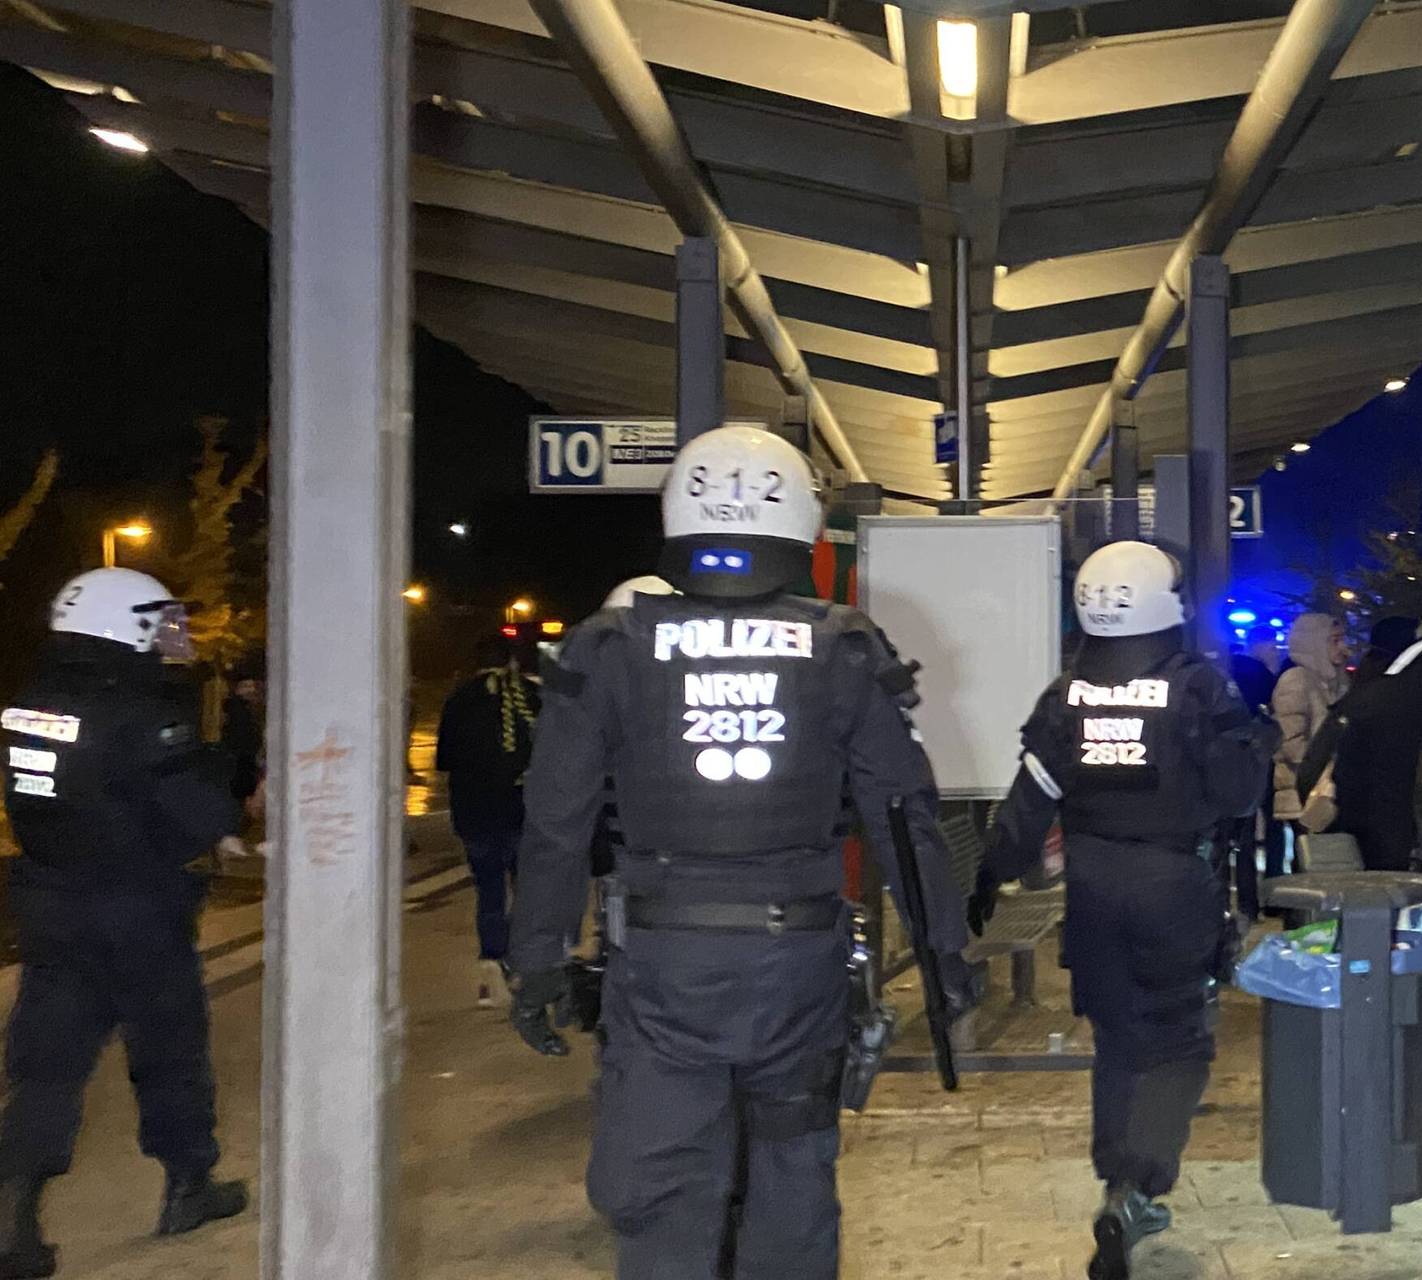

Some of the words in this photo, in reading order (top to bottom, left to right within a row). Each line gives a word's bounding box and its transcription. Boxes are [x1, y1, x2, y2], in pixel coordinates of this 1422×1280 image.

[541, 431, 600, 477] 10
[687, 465, 785, 504] 8-1-2
[654, 618, 814, 662] POLIZEI
[684, 672, 779, 707] NRW
[682, 708, 787, 743] 2812
